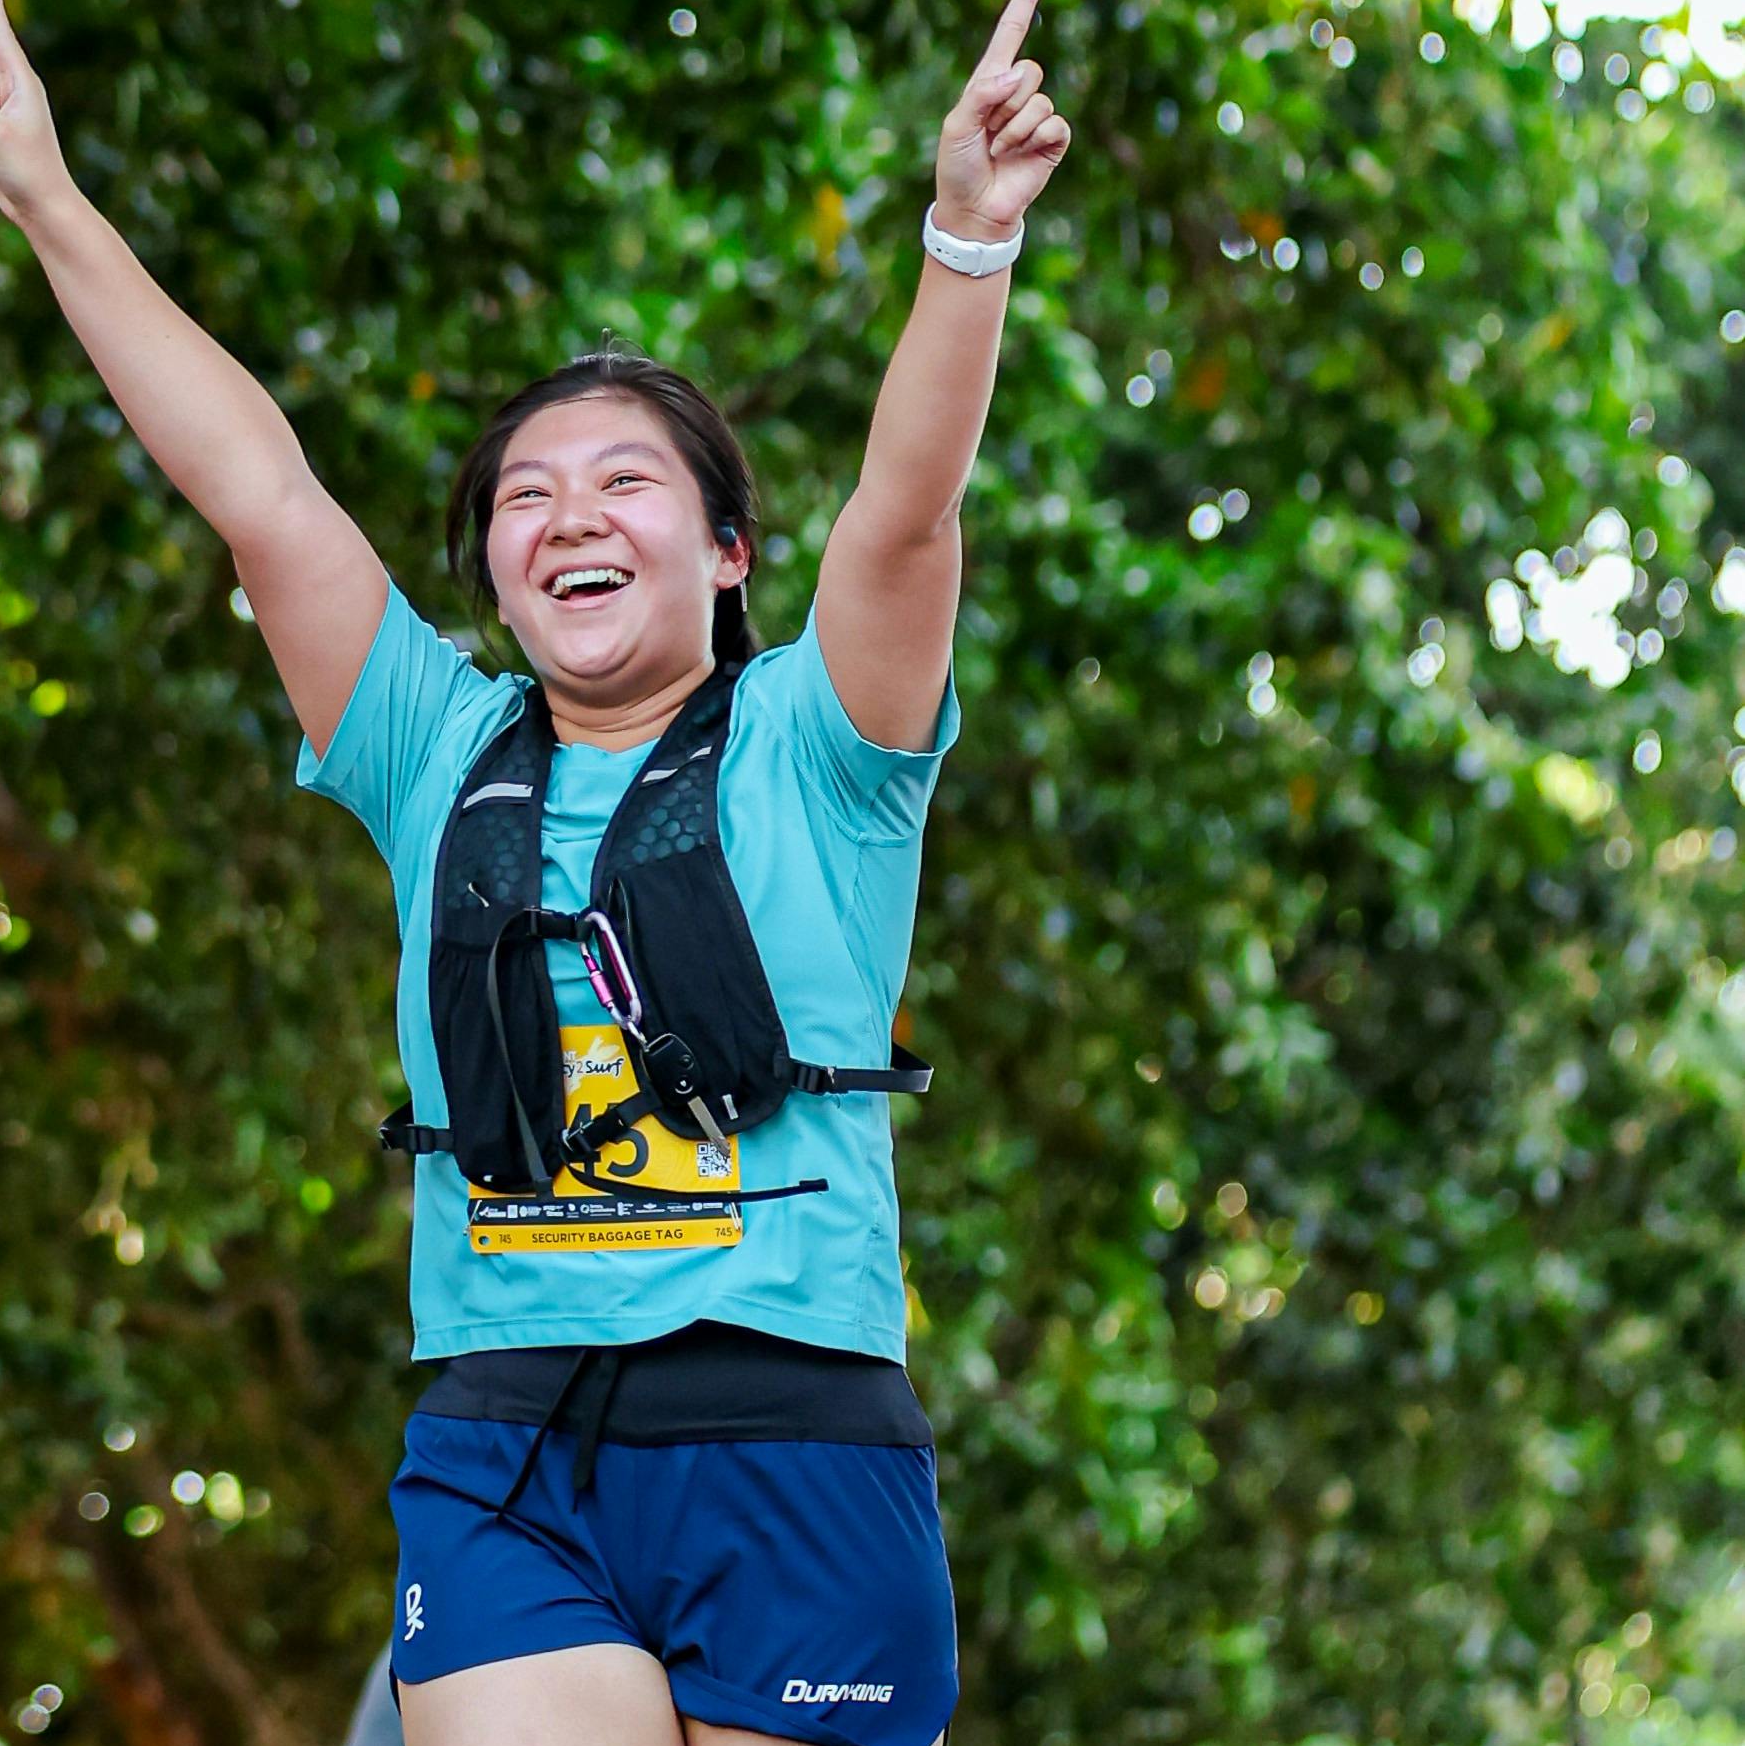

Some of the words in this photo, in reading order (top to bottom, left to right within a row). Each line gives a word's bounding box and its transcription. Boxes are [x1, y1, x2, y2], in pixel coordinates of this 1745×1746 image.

[532, 1232, 585, 1243] SECURITY
[589, 1230, 652, 1243] BAGGAGE
[656, 1228, 683, 1240] TAG
[714, 1227, 733, 1238] 745
[498, 1234, 512, 1244] 745
